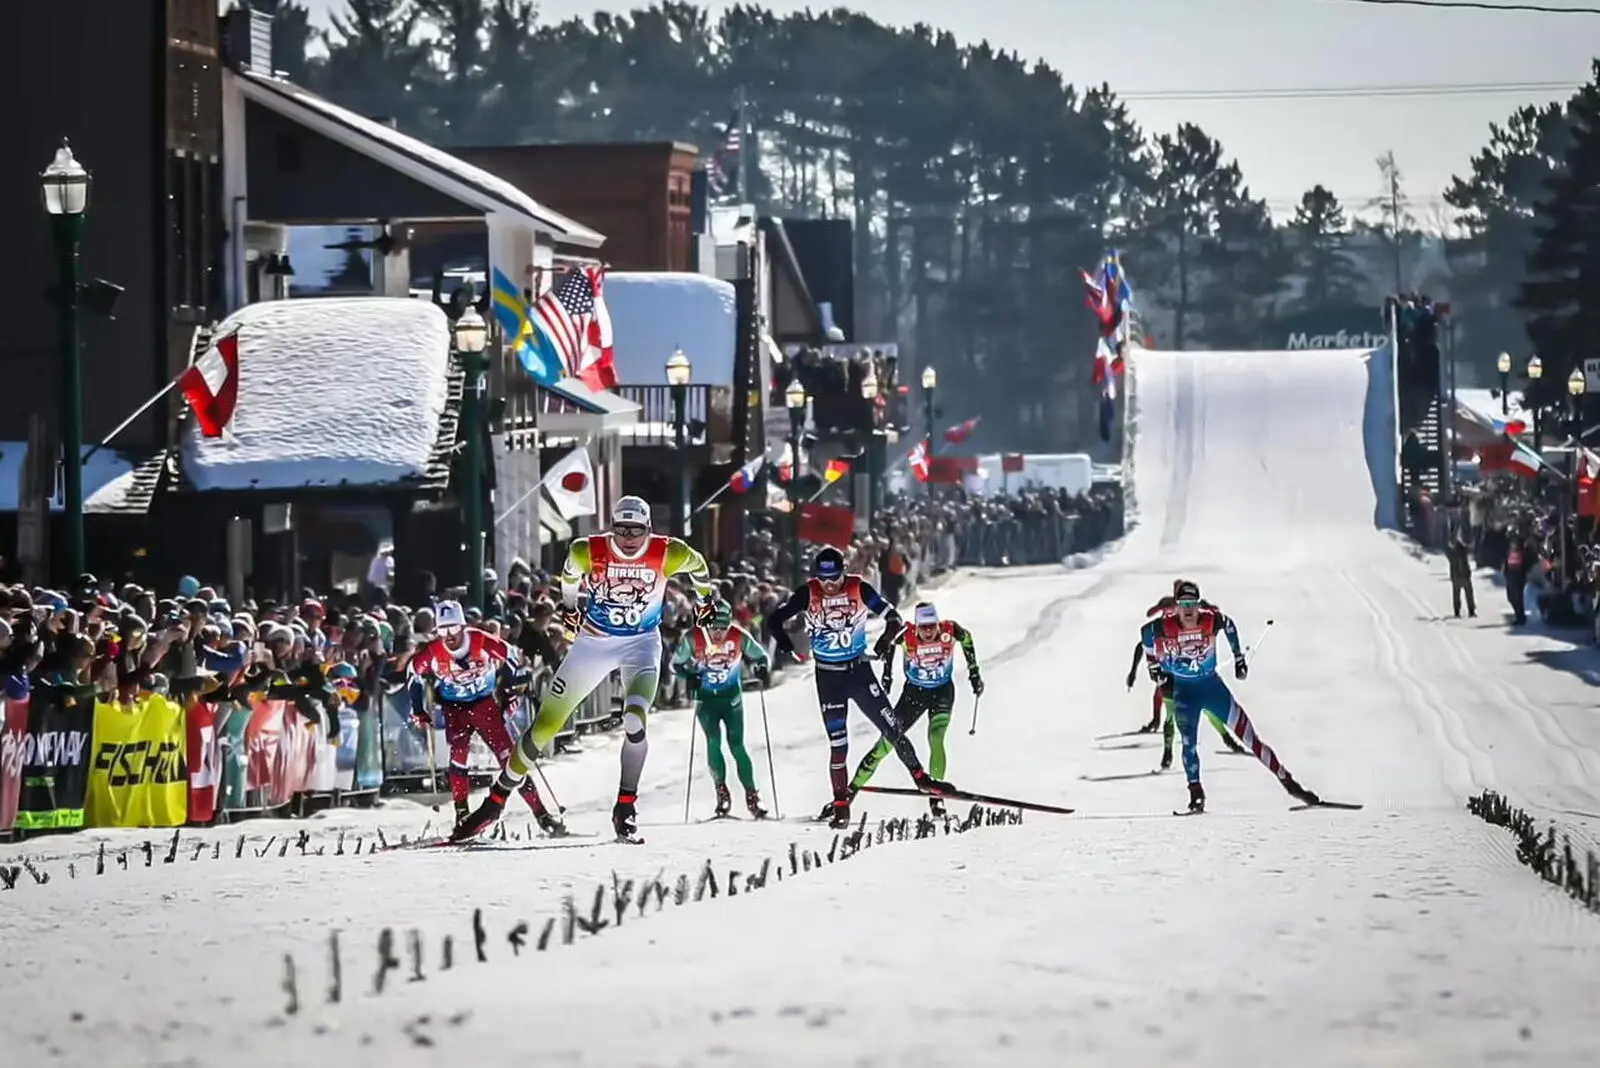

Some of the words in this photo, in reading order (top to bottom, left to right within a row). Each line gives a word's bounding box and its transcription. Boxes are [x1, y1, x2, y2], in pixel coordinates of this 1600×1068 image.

[607, 567, 646, 579] BIRKI
[609, 607, 641, 626] 60
[828, 631, 852, 650] 20
